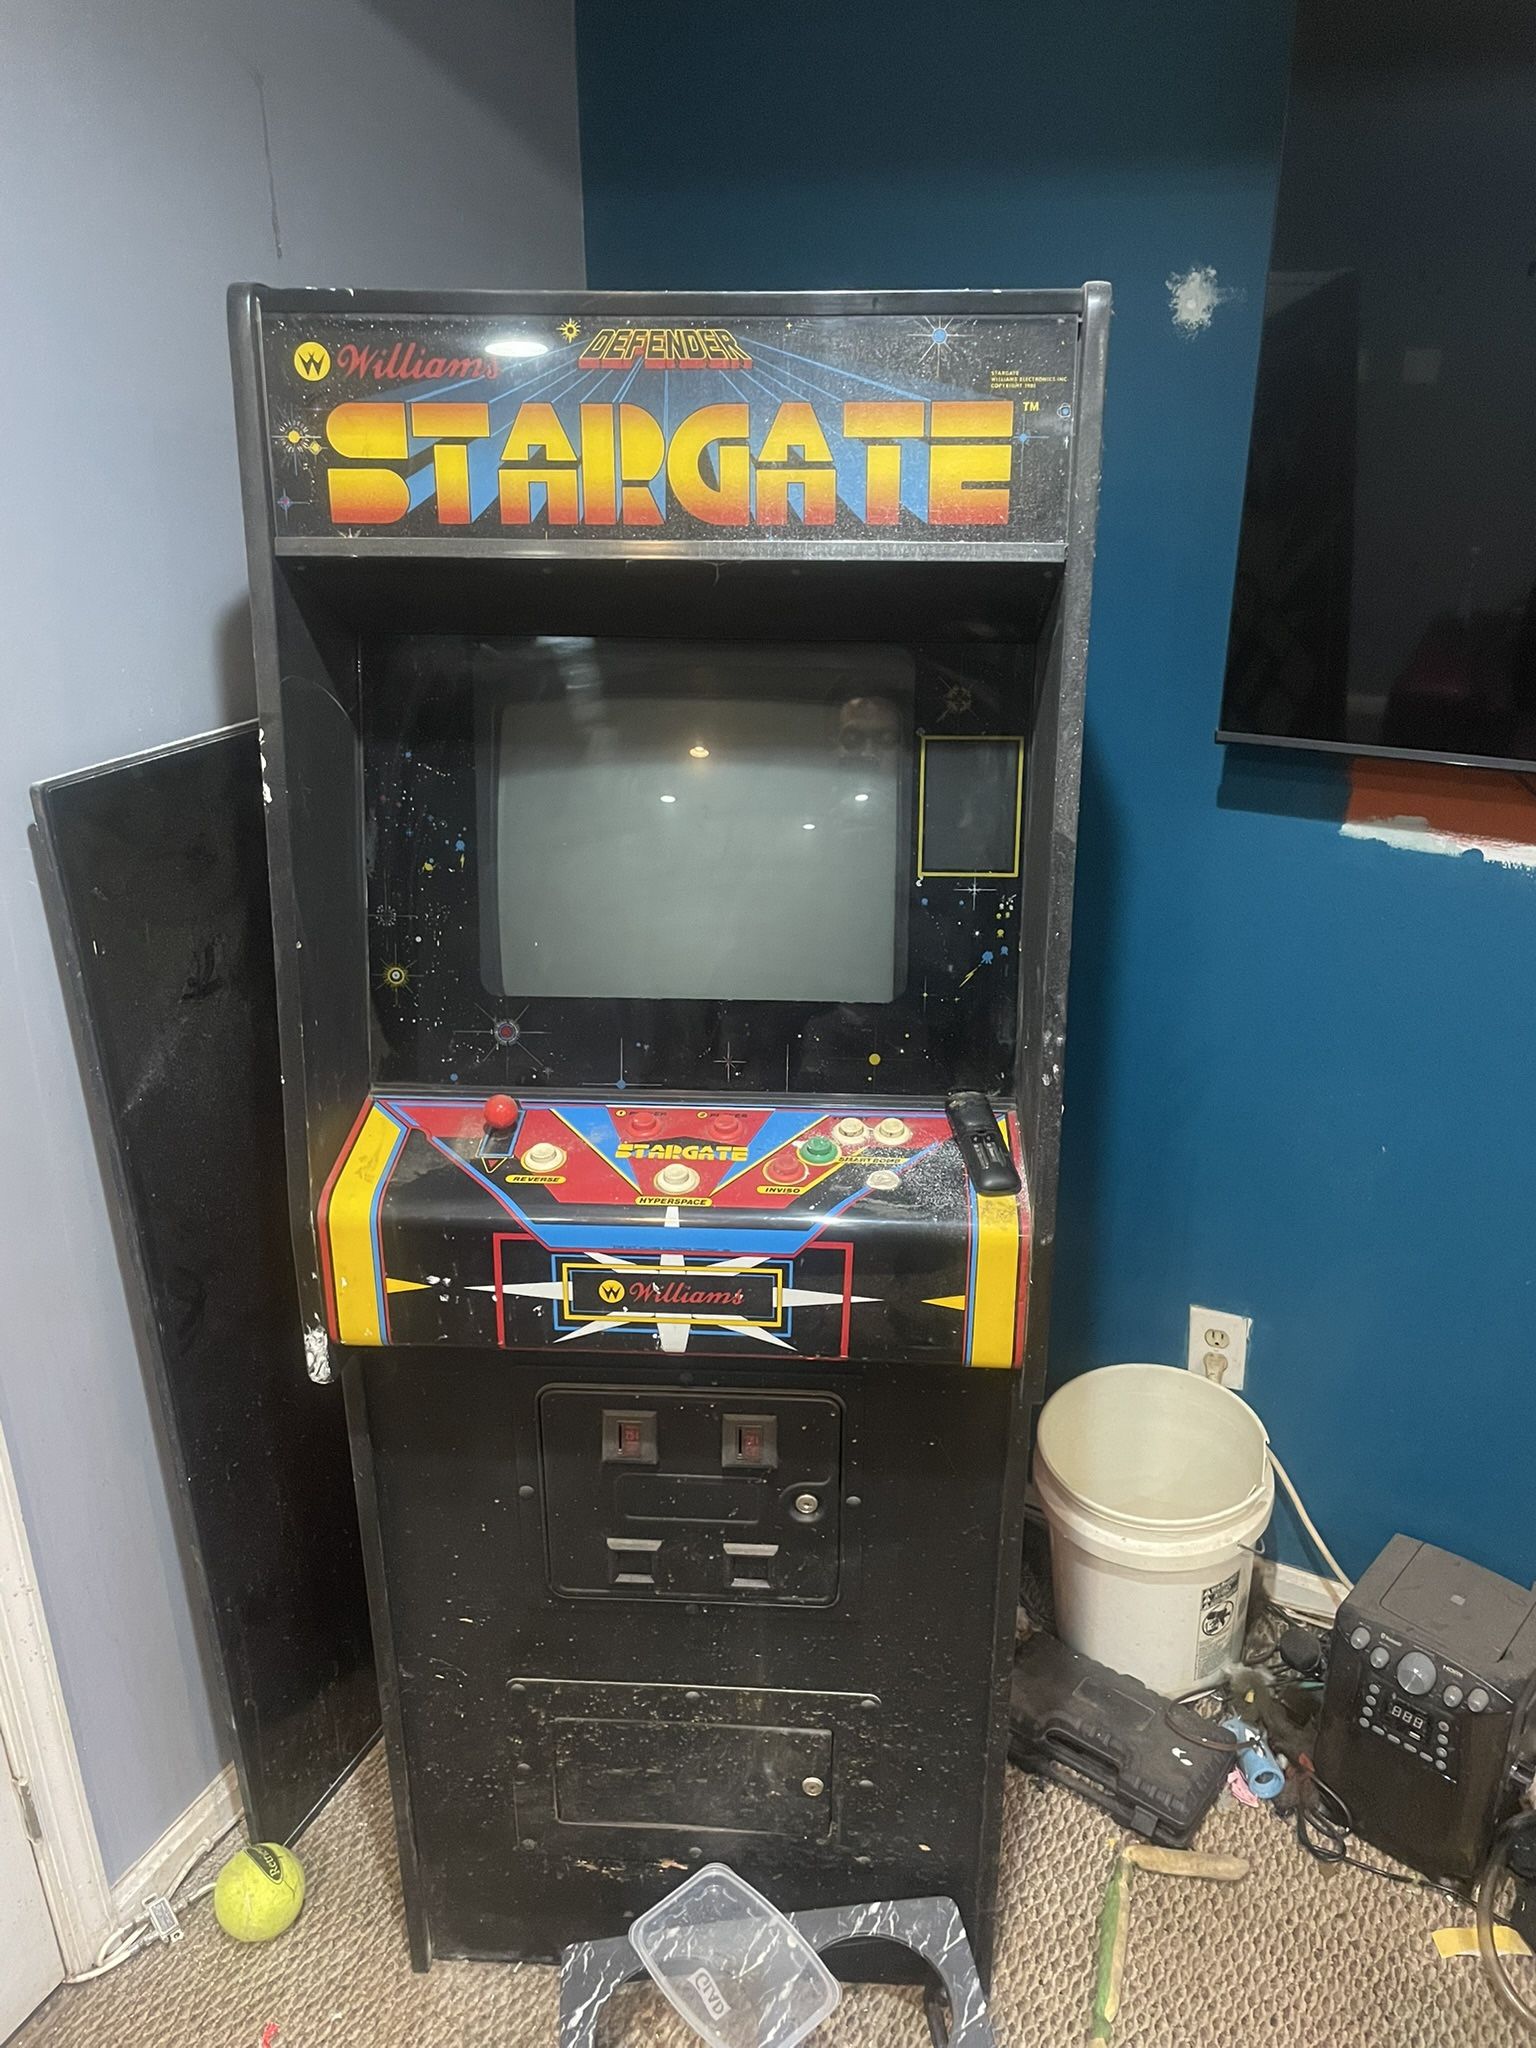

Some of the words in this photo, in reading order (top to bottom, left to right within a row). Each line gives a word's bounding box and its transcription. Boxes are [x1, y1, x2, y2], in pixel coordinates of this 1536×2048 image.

[578, 328, 752, 369] DEFENDER
[337, 342, 499, 382] Williams
[1022, 401, 1040, 412] TM
[326, 400, 1014, 526] STARGATE
[615, 1143, 748, 1162] STARGATE
[638, 1197, 707, 1206] HYPERSPACE
[628, 1281, 745, 1305] Williams
